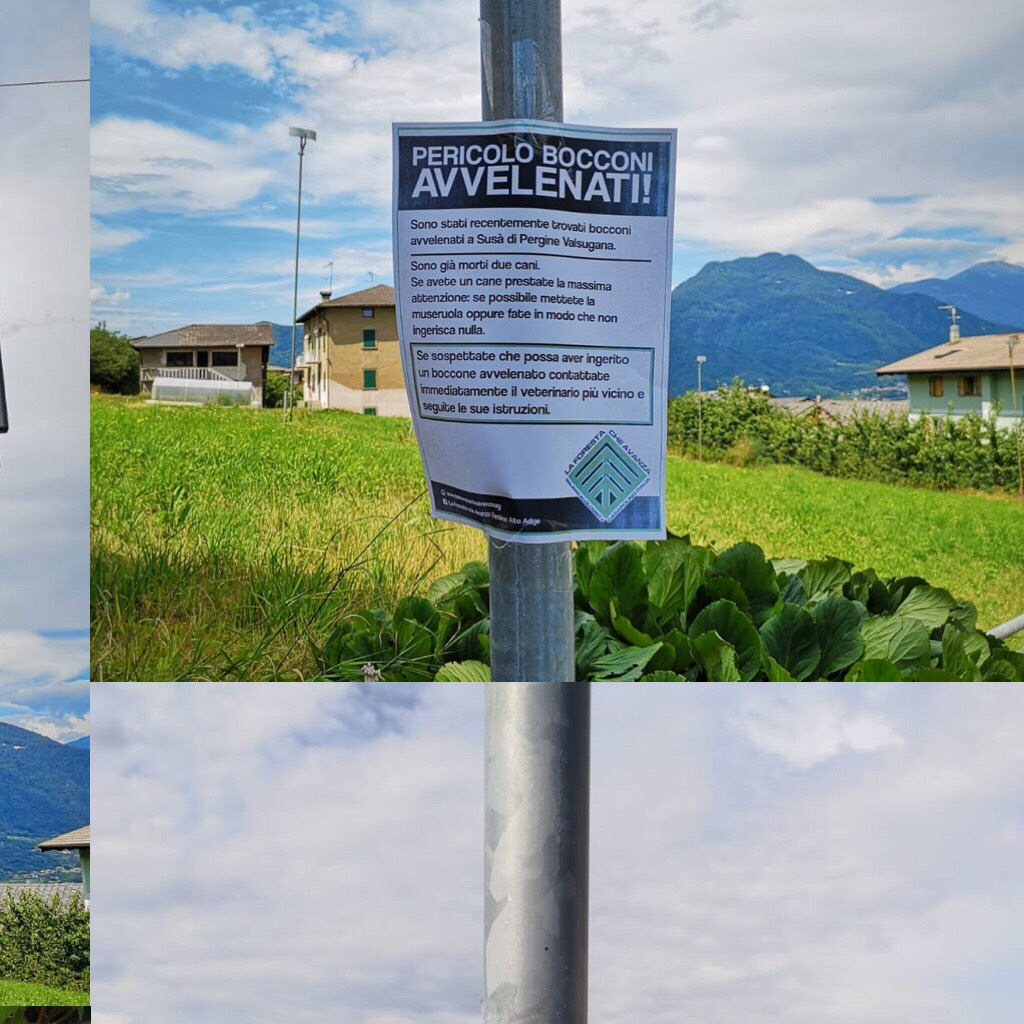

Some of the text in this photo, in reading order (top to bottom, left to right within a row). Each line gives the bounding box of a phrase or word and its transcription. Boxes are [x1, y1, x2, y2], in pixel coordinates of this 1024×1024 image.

[412, 142, 653, 172] PERICOLO BOCCONI
[411, 164, 652, 204] AVVELENATI!
[410, 218, 631, 235] Sono stati recentemente trovati bocconi
[410, 233, 616, 252] avvelenati a Susà di Pergine Valsugana.
[410, 259, 540, 273] Sono già morti due cani.
[416, 349, 629, 367] Se sospettate che possa aver ingerito
[422, 401, 550, 415] seguite le sue istruzioni.
[564, 463, 574, 475] LA
[573, 430, 606, 464] FORESTA
[608, 429, 625, 445] CHE
[622, 445, 651, 475] AVANZA
